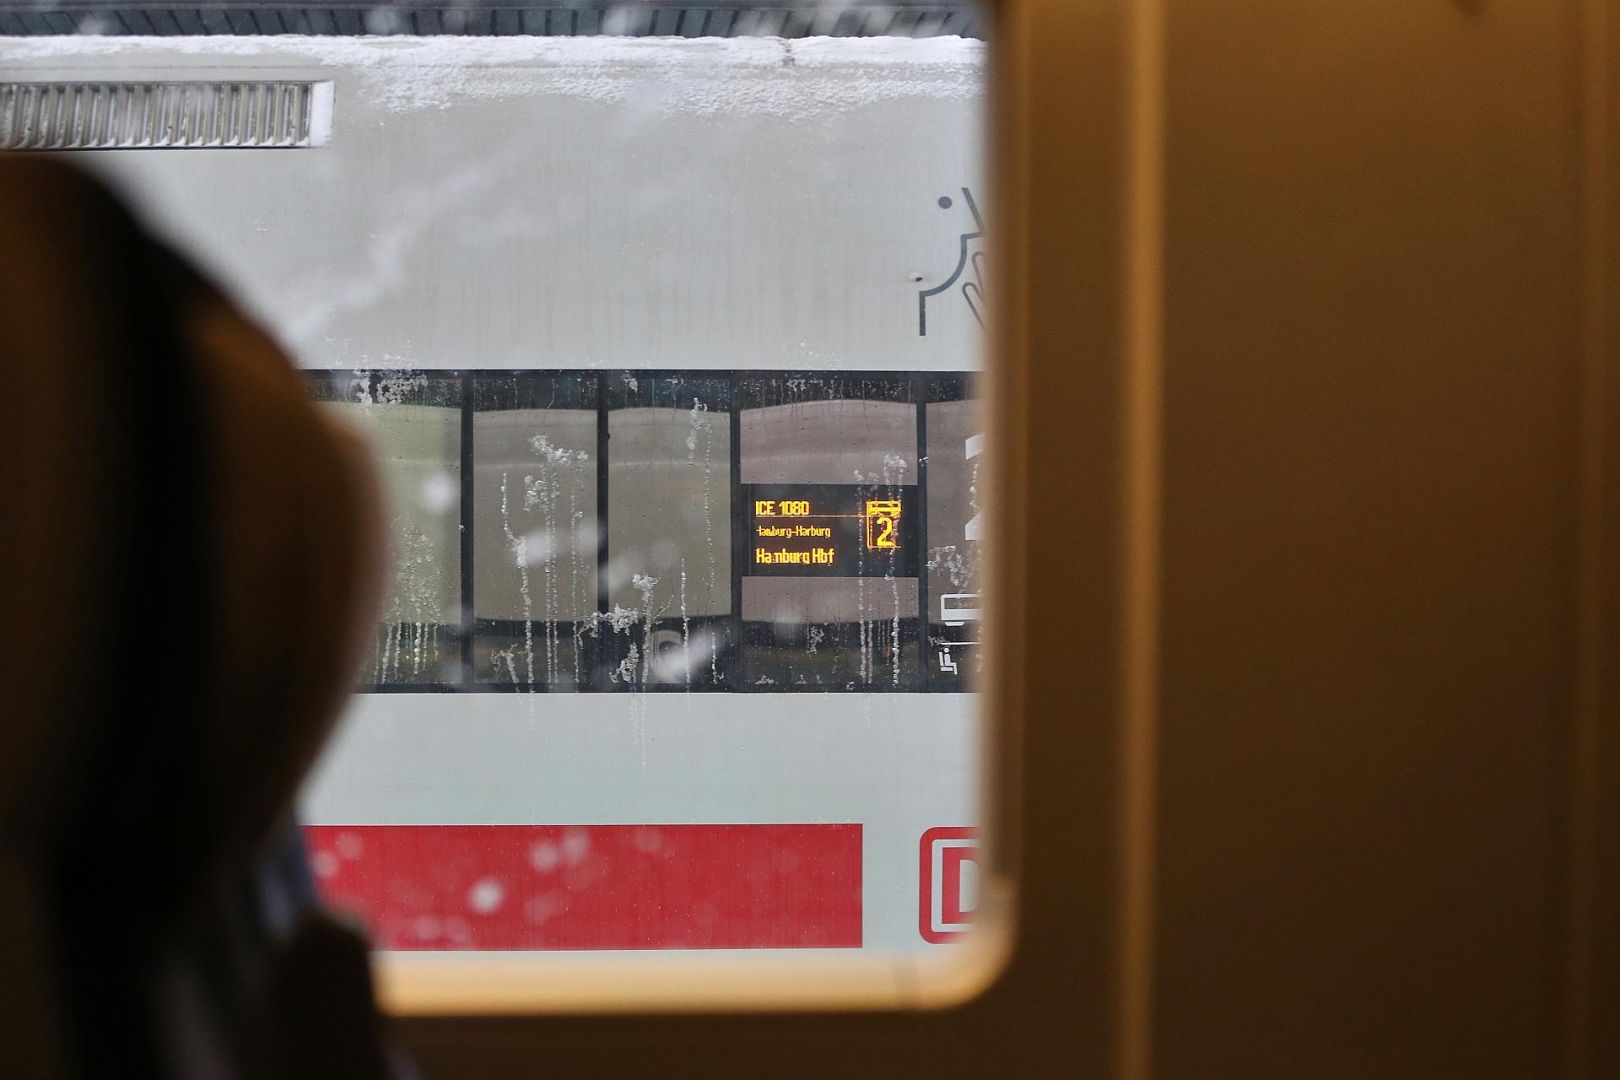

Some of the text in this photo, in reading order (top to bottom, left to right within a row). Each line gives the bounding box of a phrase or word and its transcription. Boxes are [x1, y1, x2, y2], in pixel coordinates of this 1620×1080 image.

[755, 500, 810, 515] ICE 1080
[876, 517, 895, 548] 2
[755, 547, 835, 564] Hamburg Hbf
